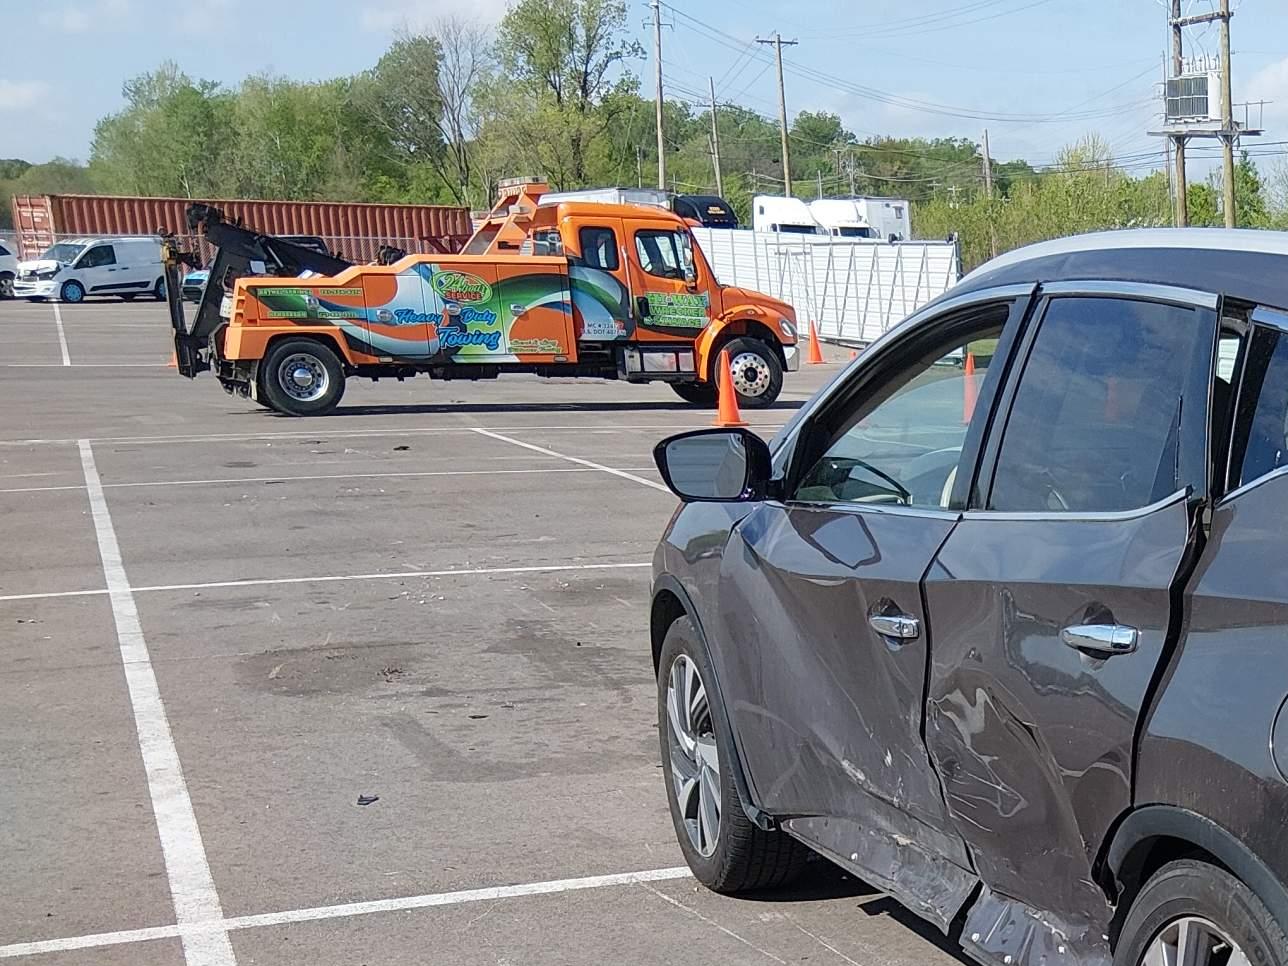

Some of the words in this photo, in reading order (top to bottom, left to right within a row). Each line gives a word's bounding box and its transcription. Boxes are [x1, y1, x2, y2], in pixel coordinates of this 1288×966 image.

[443, 273, 465, 291] 24
[445, 291, 482, 301] SERVICE
[394, 308, 443, 325] Heavy
[460, 307, 498, 326] Duty
[650, 305, 705, 317] WRECKER
[435, 326, 502, 351] Towing
